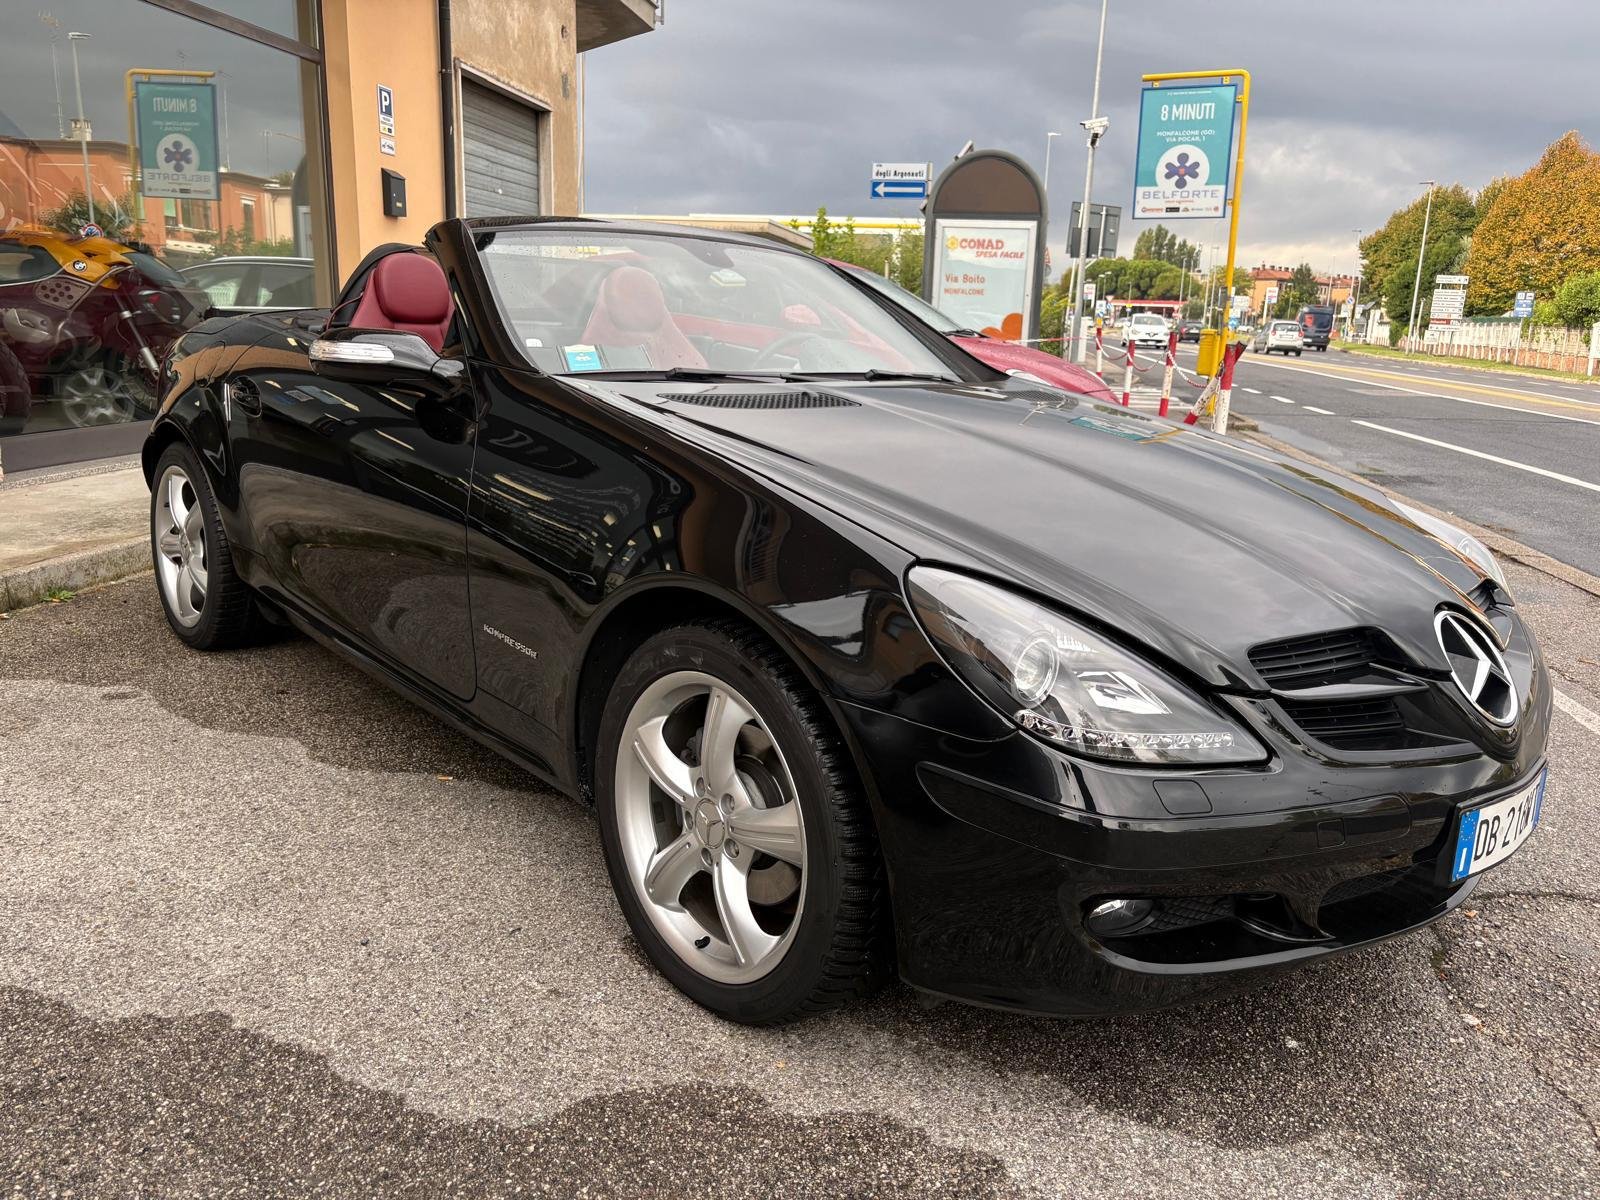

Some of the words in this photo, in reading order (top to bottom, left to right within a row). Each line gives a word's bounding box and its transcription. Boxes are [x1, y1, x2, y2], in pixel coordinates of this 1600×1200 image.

[381, 90, 390, 113] P
[1160, 104, 1169, 121] 8
[1171, 102, 1216, 121] MINUTI
[875, 169, 891, 178] degli
[893, 169, 924, 178] Argonauti
[1142, 189, 1220, 199] BELFORTE
[960, 238, 1005, 250] CONAD
[975, 250, 998, 258] SPESA
[999, 251, 1025, 259] FACILE
[945, 273, 959, 283] Via
[962, 273, 986, 284] Boito
[943, 287, 985, 296] MONFALCONE
[483, 623, 537, 660] KOMPRESSOR
[1473, 815, 1500, 861] DB
